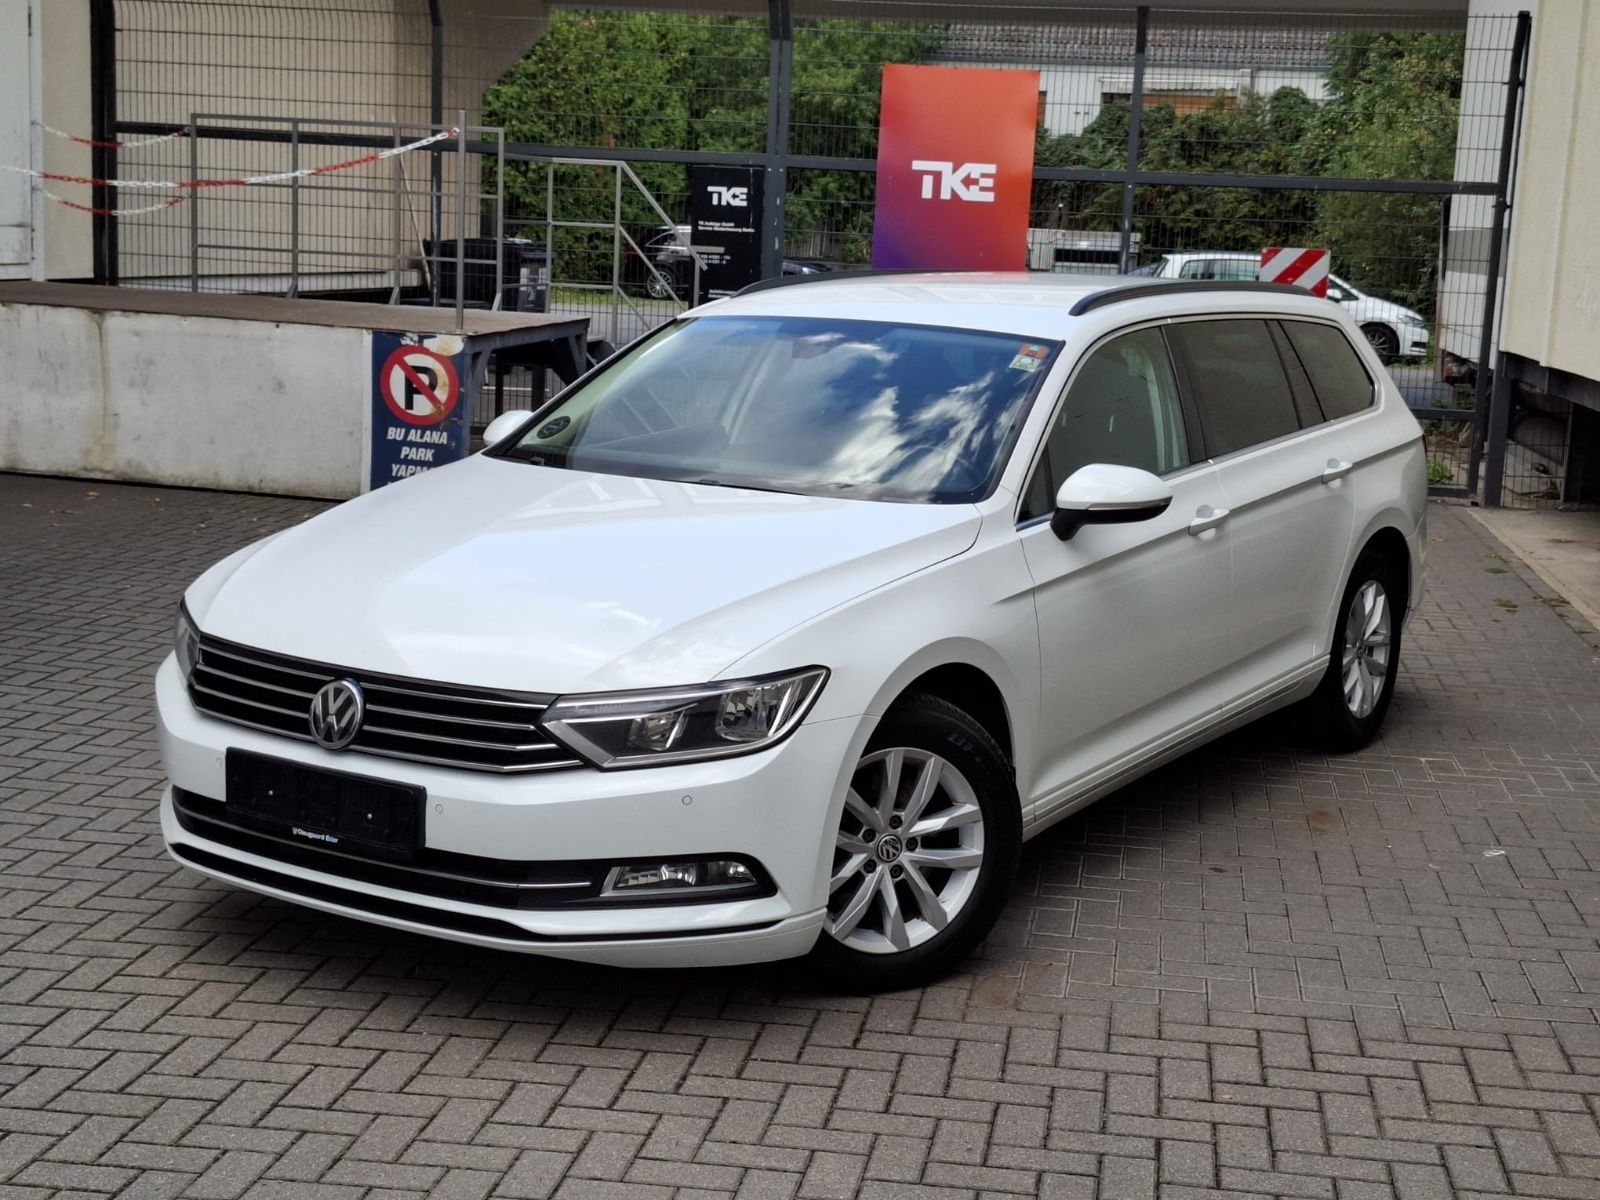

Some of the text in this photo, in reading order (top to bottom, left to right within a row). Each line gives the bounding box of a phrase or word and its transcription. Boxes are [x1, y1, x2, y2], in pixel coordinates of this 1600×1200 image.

[912, 160, 997, 202] TKE
[707, 185, 748, 207] TKE
[386, 427, 448, 445] BU ALANA
[400, 446, 435, 462] PARK
[391, 463, 430, 478] YAPM
